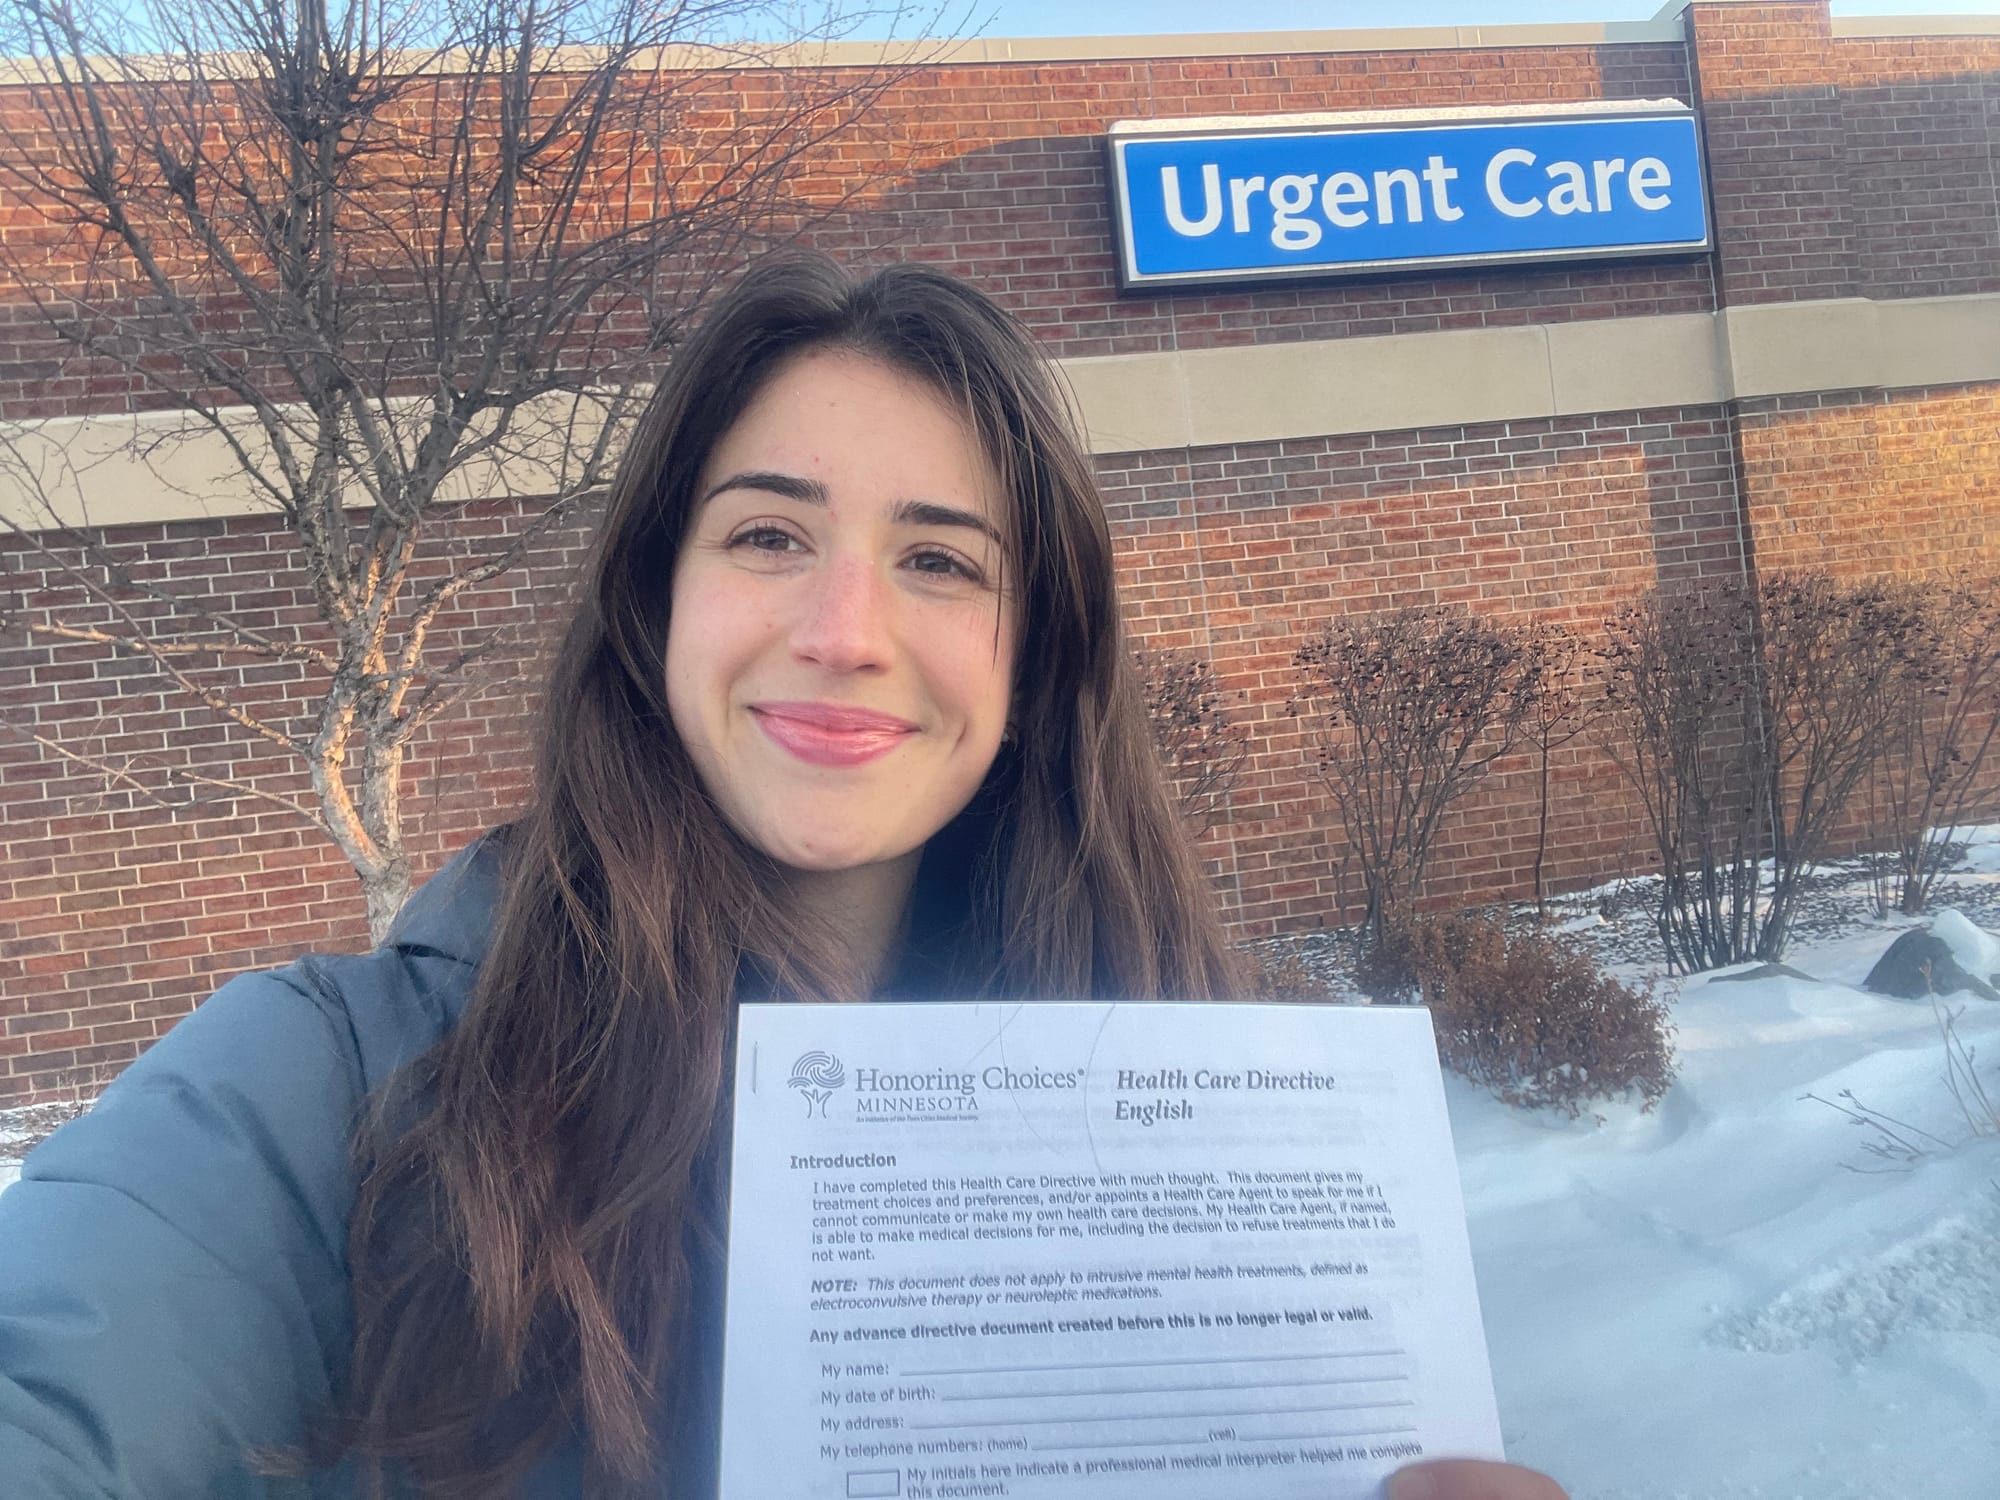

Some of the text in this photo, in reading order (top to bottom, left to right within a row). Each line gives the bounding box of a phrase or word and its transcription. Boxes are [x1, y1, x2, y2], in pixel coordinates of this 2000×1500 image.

[1160, 148, 1672, 250] Urgent Care
[856, 1068, 976, 1095] Honoring
[1118, 1070, 1335, 1090] Health Care Directive
[857, 1096, 979, 1112] MINNESOTA
[1115, 1099, 1193, 1127] English
[790, 1152, 897, 1170] Introduction
[814, 1170, 1363, 1194] I have completed this Health Care Directive with much thought. This document gives my
[813, 1198, 878, 1210] treatment
[884, 1196, 931, 1209] choices
[936, 1194, 960, 1207] and
[965, 1192, 1044, 1208] preferences,
[1048, 1191, 1090, 1204] and/or
[1096, 1190, 1148, 1205] appoints
[1152, 1191, 1160, 1201] a
[1165, 1188, 1204, 1201] Health
[1207, 1188, 1235, 1200] Care
[1239, 1186, 1274, 1202] Agent
[1276, 1186, 1288, 1198] to
[1292, 1185, 1324, 1200] speak
[1328, 1185, 1343, 1198] for
[1346, 1187, 1363, 1198] me
[1367, 1185, 1374, 1197] if
[813, 1215, 858, 1227] cannot
[862, 1212, 950, 1226] communicate
[955, 1212, 968, 1223] or
[973, 1210, 1008, 1223] make
[1013, 1210, 1032, 1224] my
[1037, 1208, 1062, 1220] own
[1068, 1206, 1106, 1219] health
[1112, 1207, 1138, 1218] care
[1142, 1204, 1202, 1218] decisions.
[1206, 1204, 1223, 1218] My
[1228, 1202, 1266, 1215] Health
[1270, 1202, 1297, 1215] Care
[1300, 1200, 1336, 1216] Agent,
[1340, 1201, 1347, 1213] if
[812, 1216, 1396, 1244] is able to make medical decisions for me, including the decision to refuse treatments that I do
[812, 1248, 875, 1262] not want.
[811, 1280, 857, 1293] NOTE:
[868, 1277, 894, 1290] This
[900, 1275, 965, 1290] document
[970, 1274, 1000, 1288] does
[1005, 1273, 1025, 1286] not
[1030, 1270, 1065, 1287] apply
[1070, 1270, 1082, 1284] to
[1088, 1268, 1143, 1283] intrusive
[1147, 1266, 1191, 1280] mental
[1195, 1265, 1233, 1279] health
[1310, 1262, 1352, 1276] defined
[1356, 1264, 1368, 1274] as
[810, 1286, 1162, 1311] electroconvulsive therapy or neuroleptic medications.
[810, 1306, 1373, 1344] Any advance directive document created before this is no longer legal or valid.
[821, 1364, 888, 1379] My name:
[821, 1384, 935, 1406] My date of birth:
[821, 1416, 903, 1433] My address:
[820, 1446, 839, 1460] My
[845, 1442, 913, 1459] telephone
[918, 1438, 982, 1454] numbers:
[988, 1437, 1027, 1452] (home)
[907, 1469, 927, 1483] My
[932, 1465, 976, 1481] initials
[981, 1464, 1011, 1478] here
[1016, 1460, 1068, 1476] indicate
[1074, 1462, 1081, 1473] a
[1086, 1456, 1166, 1475] professional
[1171, 1453, 1221, 1469] medical
[1226, 1452, 1297, 1468] interpreter
[1300, 1447, 1343, 1465] helped
[1348, 1449, 1367, 1460] me
[907, 1483, 1009, 1499] this document.
